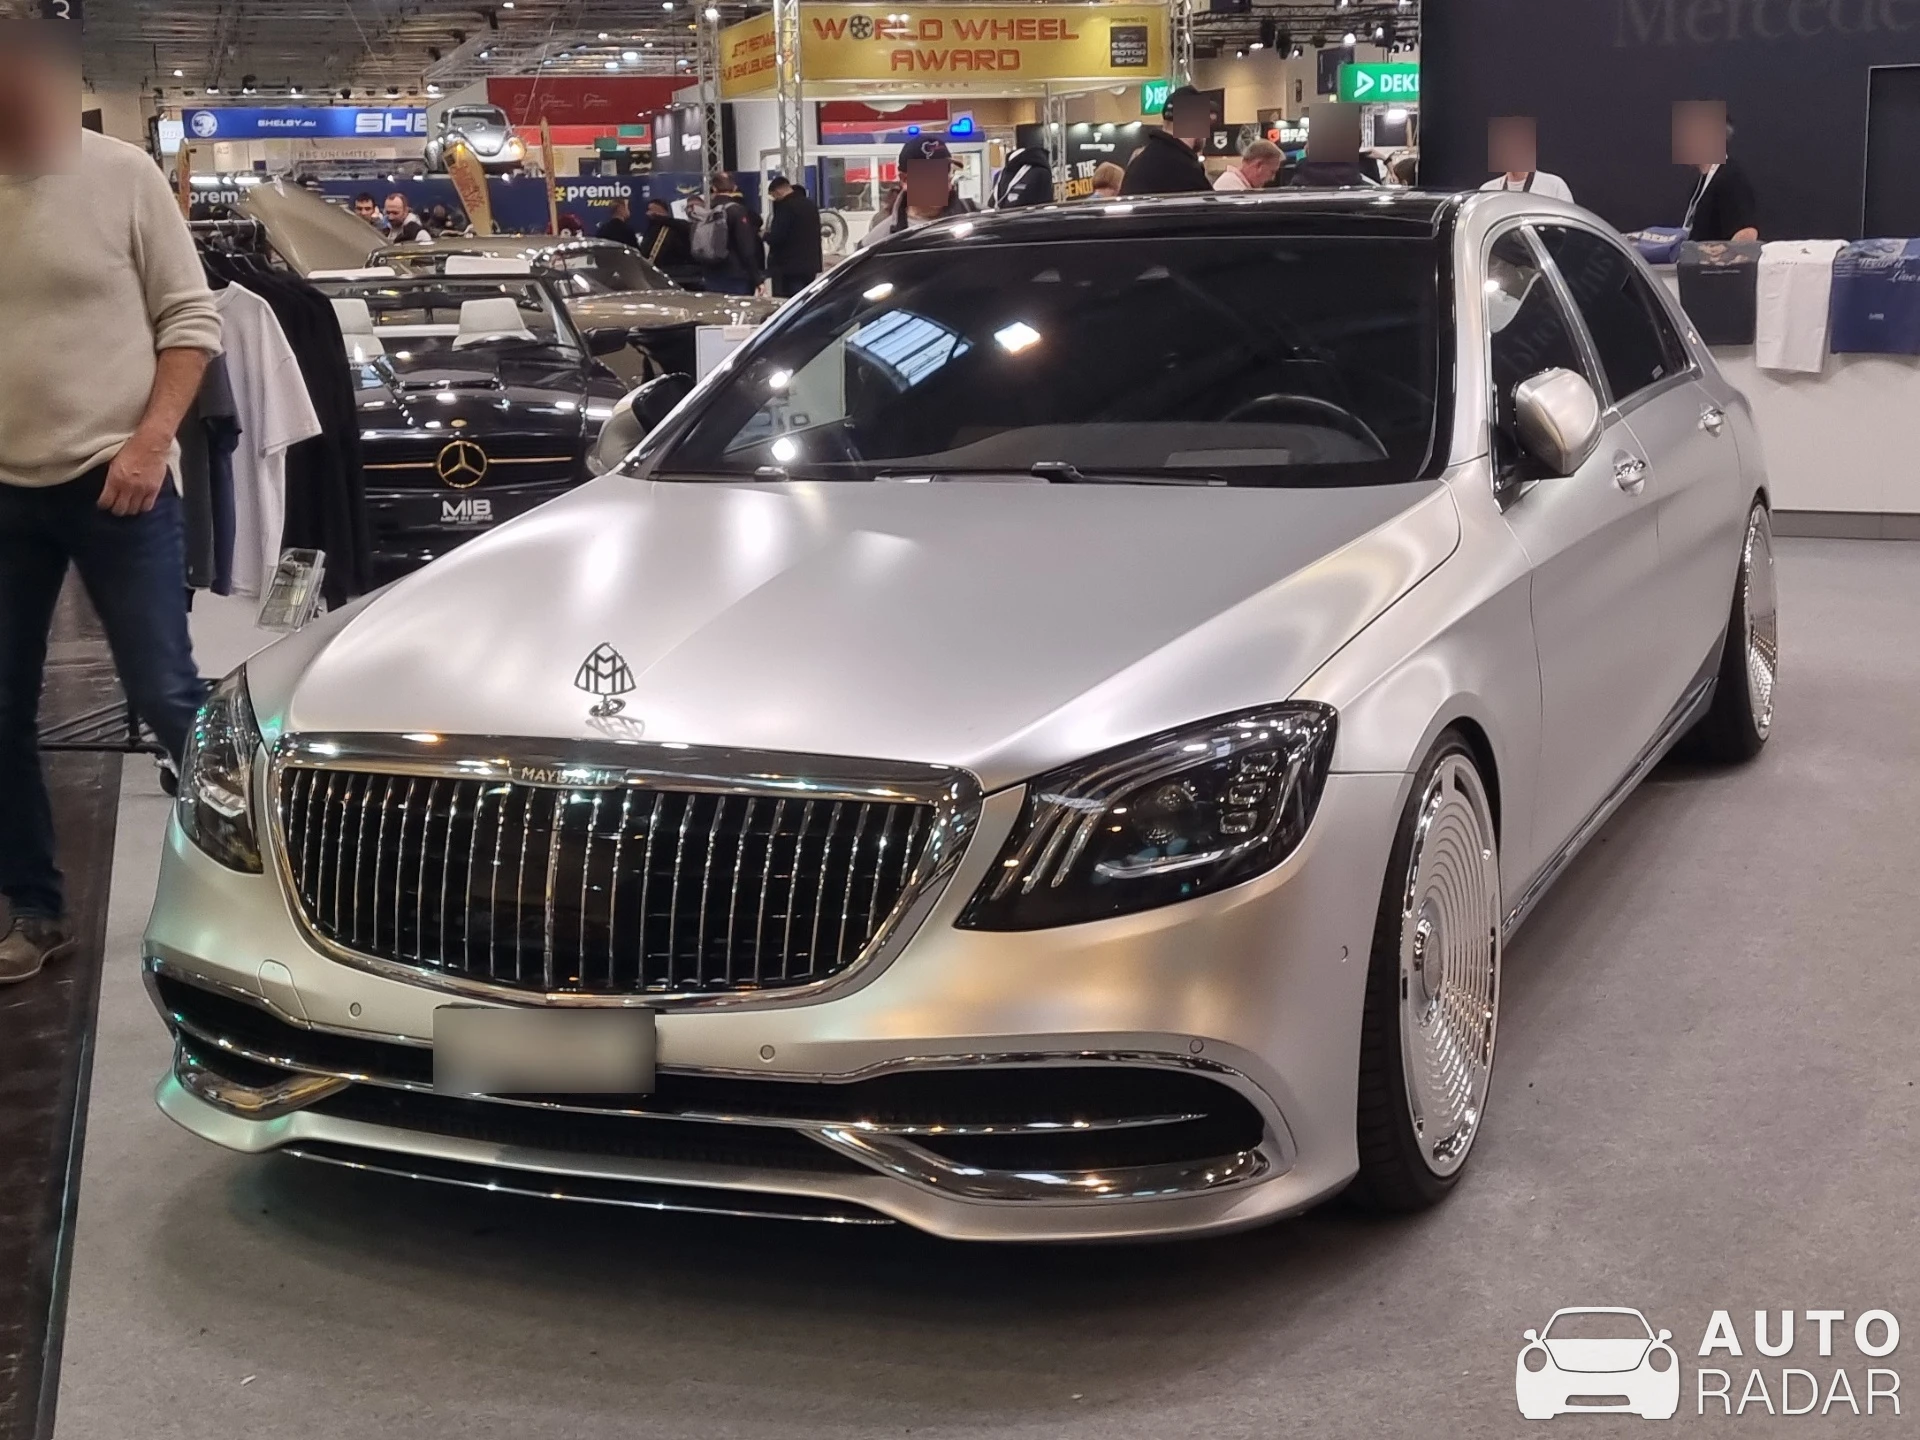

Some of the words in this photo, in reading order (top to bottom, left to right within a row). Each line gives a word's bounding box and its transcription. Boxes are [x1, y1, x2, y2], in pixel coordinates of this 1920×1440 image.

[951, 18, 1080, 40] WHEEL
[890, 48, 1020, 71] AWARD
[1380, 74, 1419, 92] DEK
[188, 190, 240, 206] prem
[566, 181, 632, 203] premio
[442, 499, 491, 516] MIB
